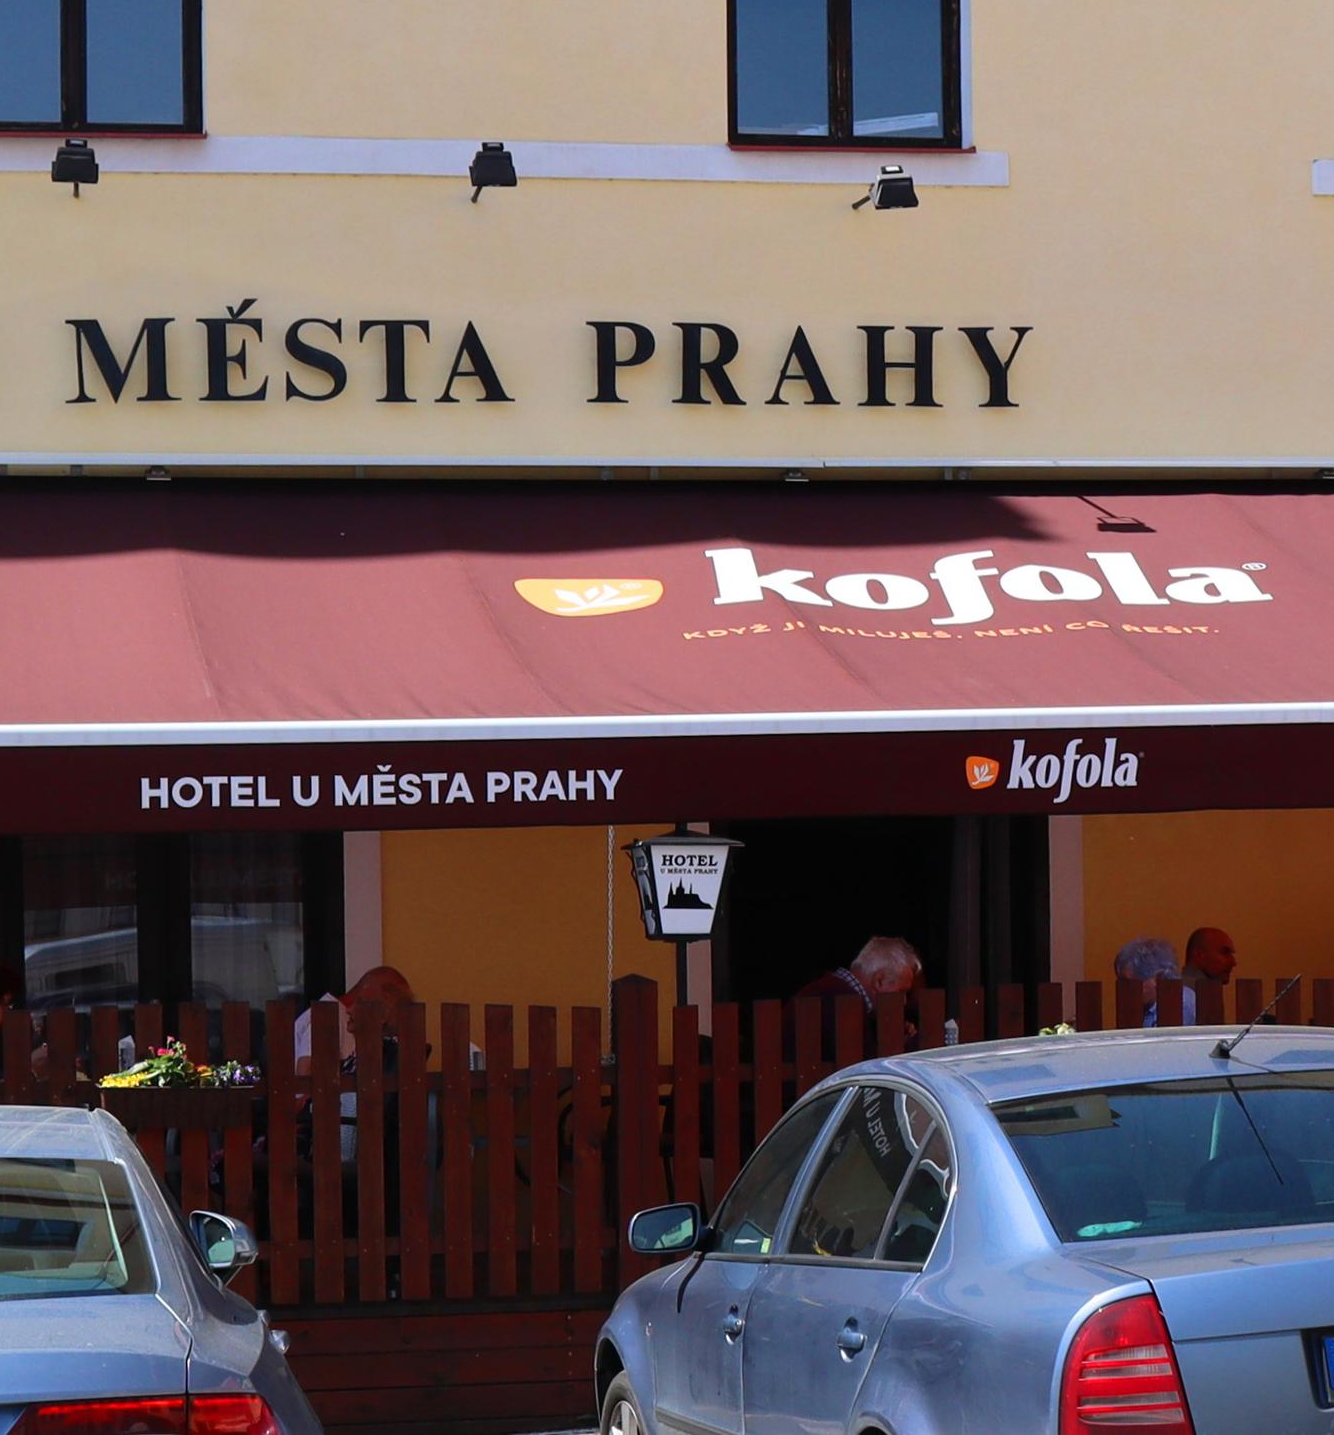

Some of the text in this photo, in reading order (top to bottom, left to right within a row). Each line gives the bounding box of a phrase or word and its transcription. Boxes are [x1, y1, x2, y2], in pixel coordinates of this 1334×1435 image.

[585, 321, 1033, 407] PRAHY
[705, 547, 1274, 626] kofola
[1065, 620, 1110, 631] CO
[140, 764, 624, 809] HOTEL U MĚSTA PRAHY
[1006, 737, 1140, 804] kofola
[661, 854, 718, 867] HOTEL
